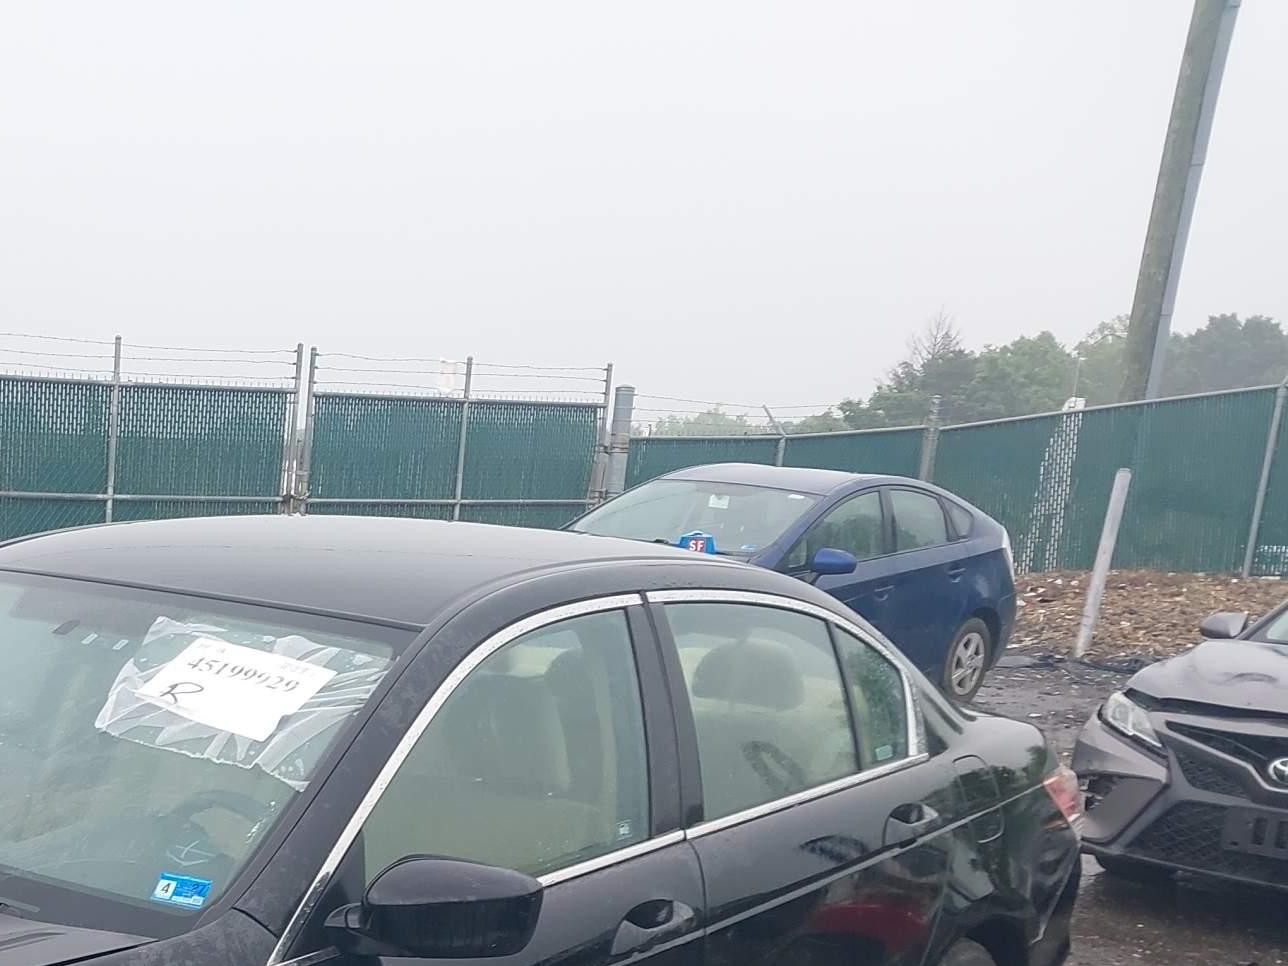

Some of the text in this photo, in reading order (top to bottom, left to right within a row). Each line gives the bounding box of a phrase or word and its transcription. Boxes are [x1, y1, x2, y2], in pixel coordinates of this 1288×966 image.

[187, 657, 300, 692] 45199929
[160, 681, 205, 705] R
[161, 882, 171, 893] 4
